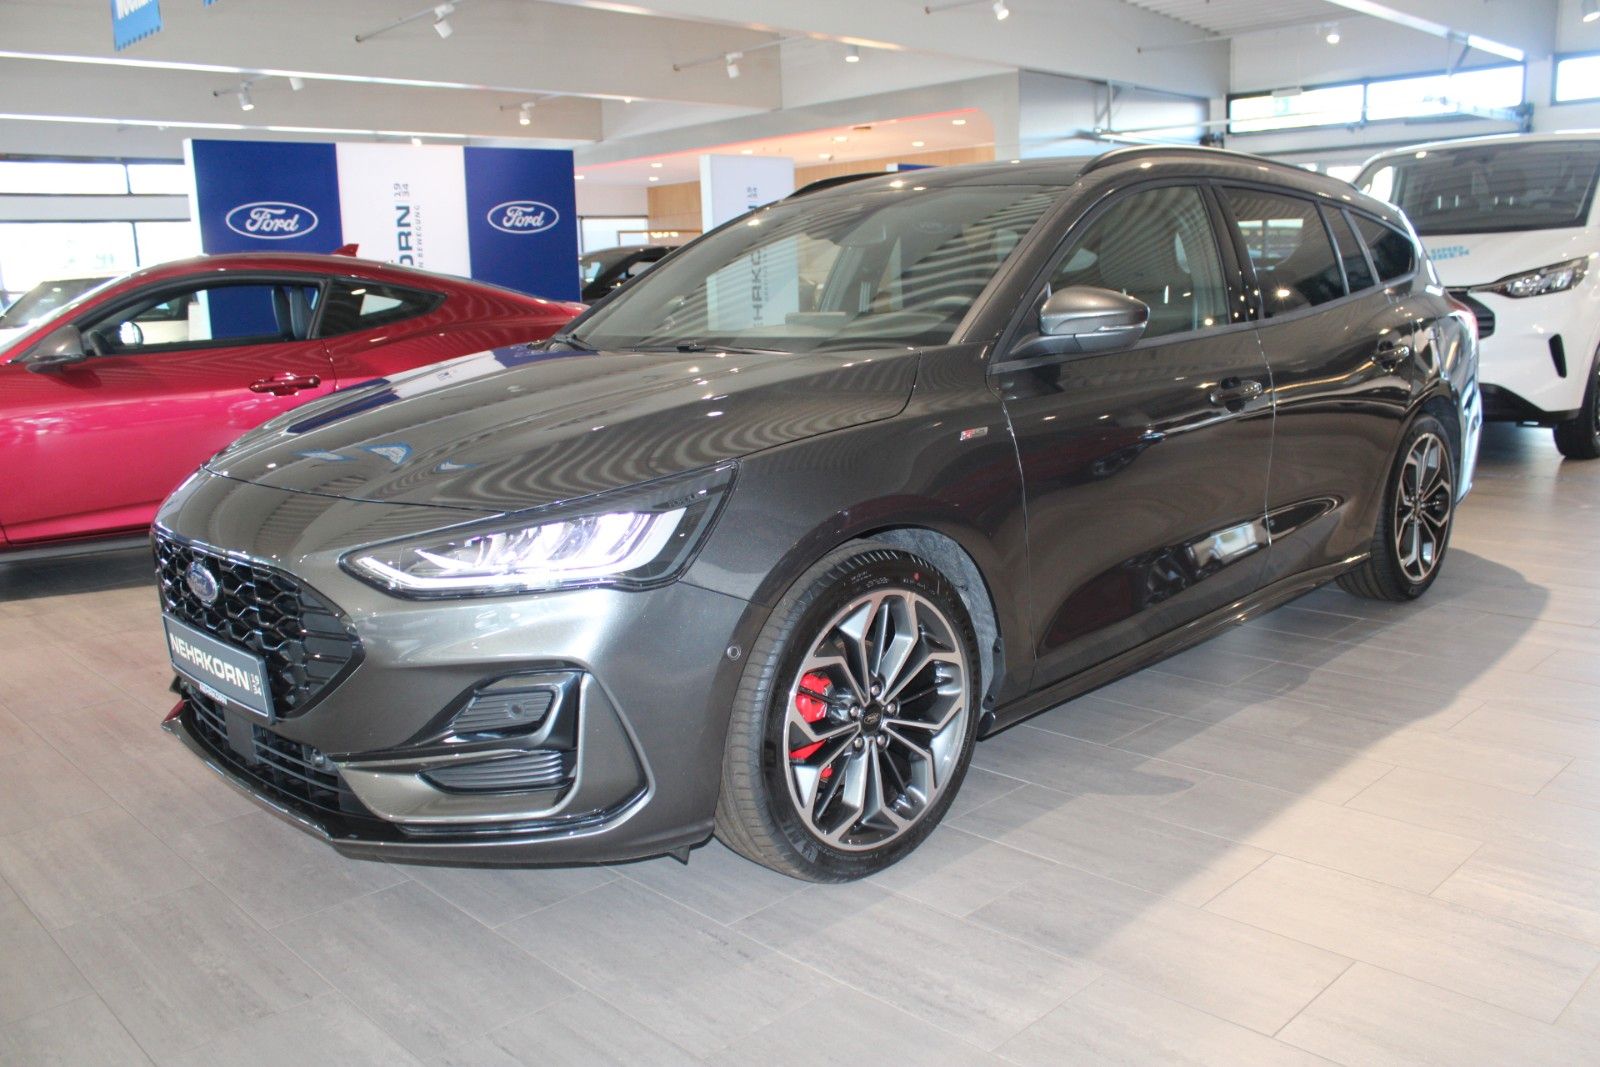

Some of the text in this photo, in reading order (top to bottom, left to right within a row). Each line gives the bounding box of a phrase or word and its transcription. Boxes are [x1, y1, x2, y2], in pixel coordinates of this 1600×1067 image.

[245, 207, 299, 231] Ford
[414, 205, 424, 258] BEWEGUNG
[502, 206, 546, 227] Ford
[169, 633, 250, 691] NEHRKORN
